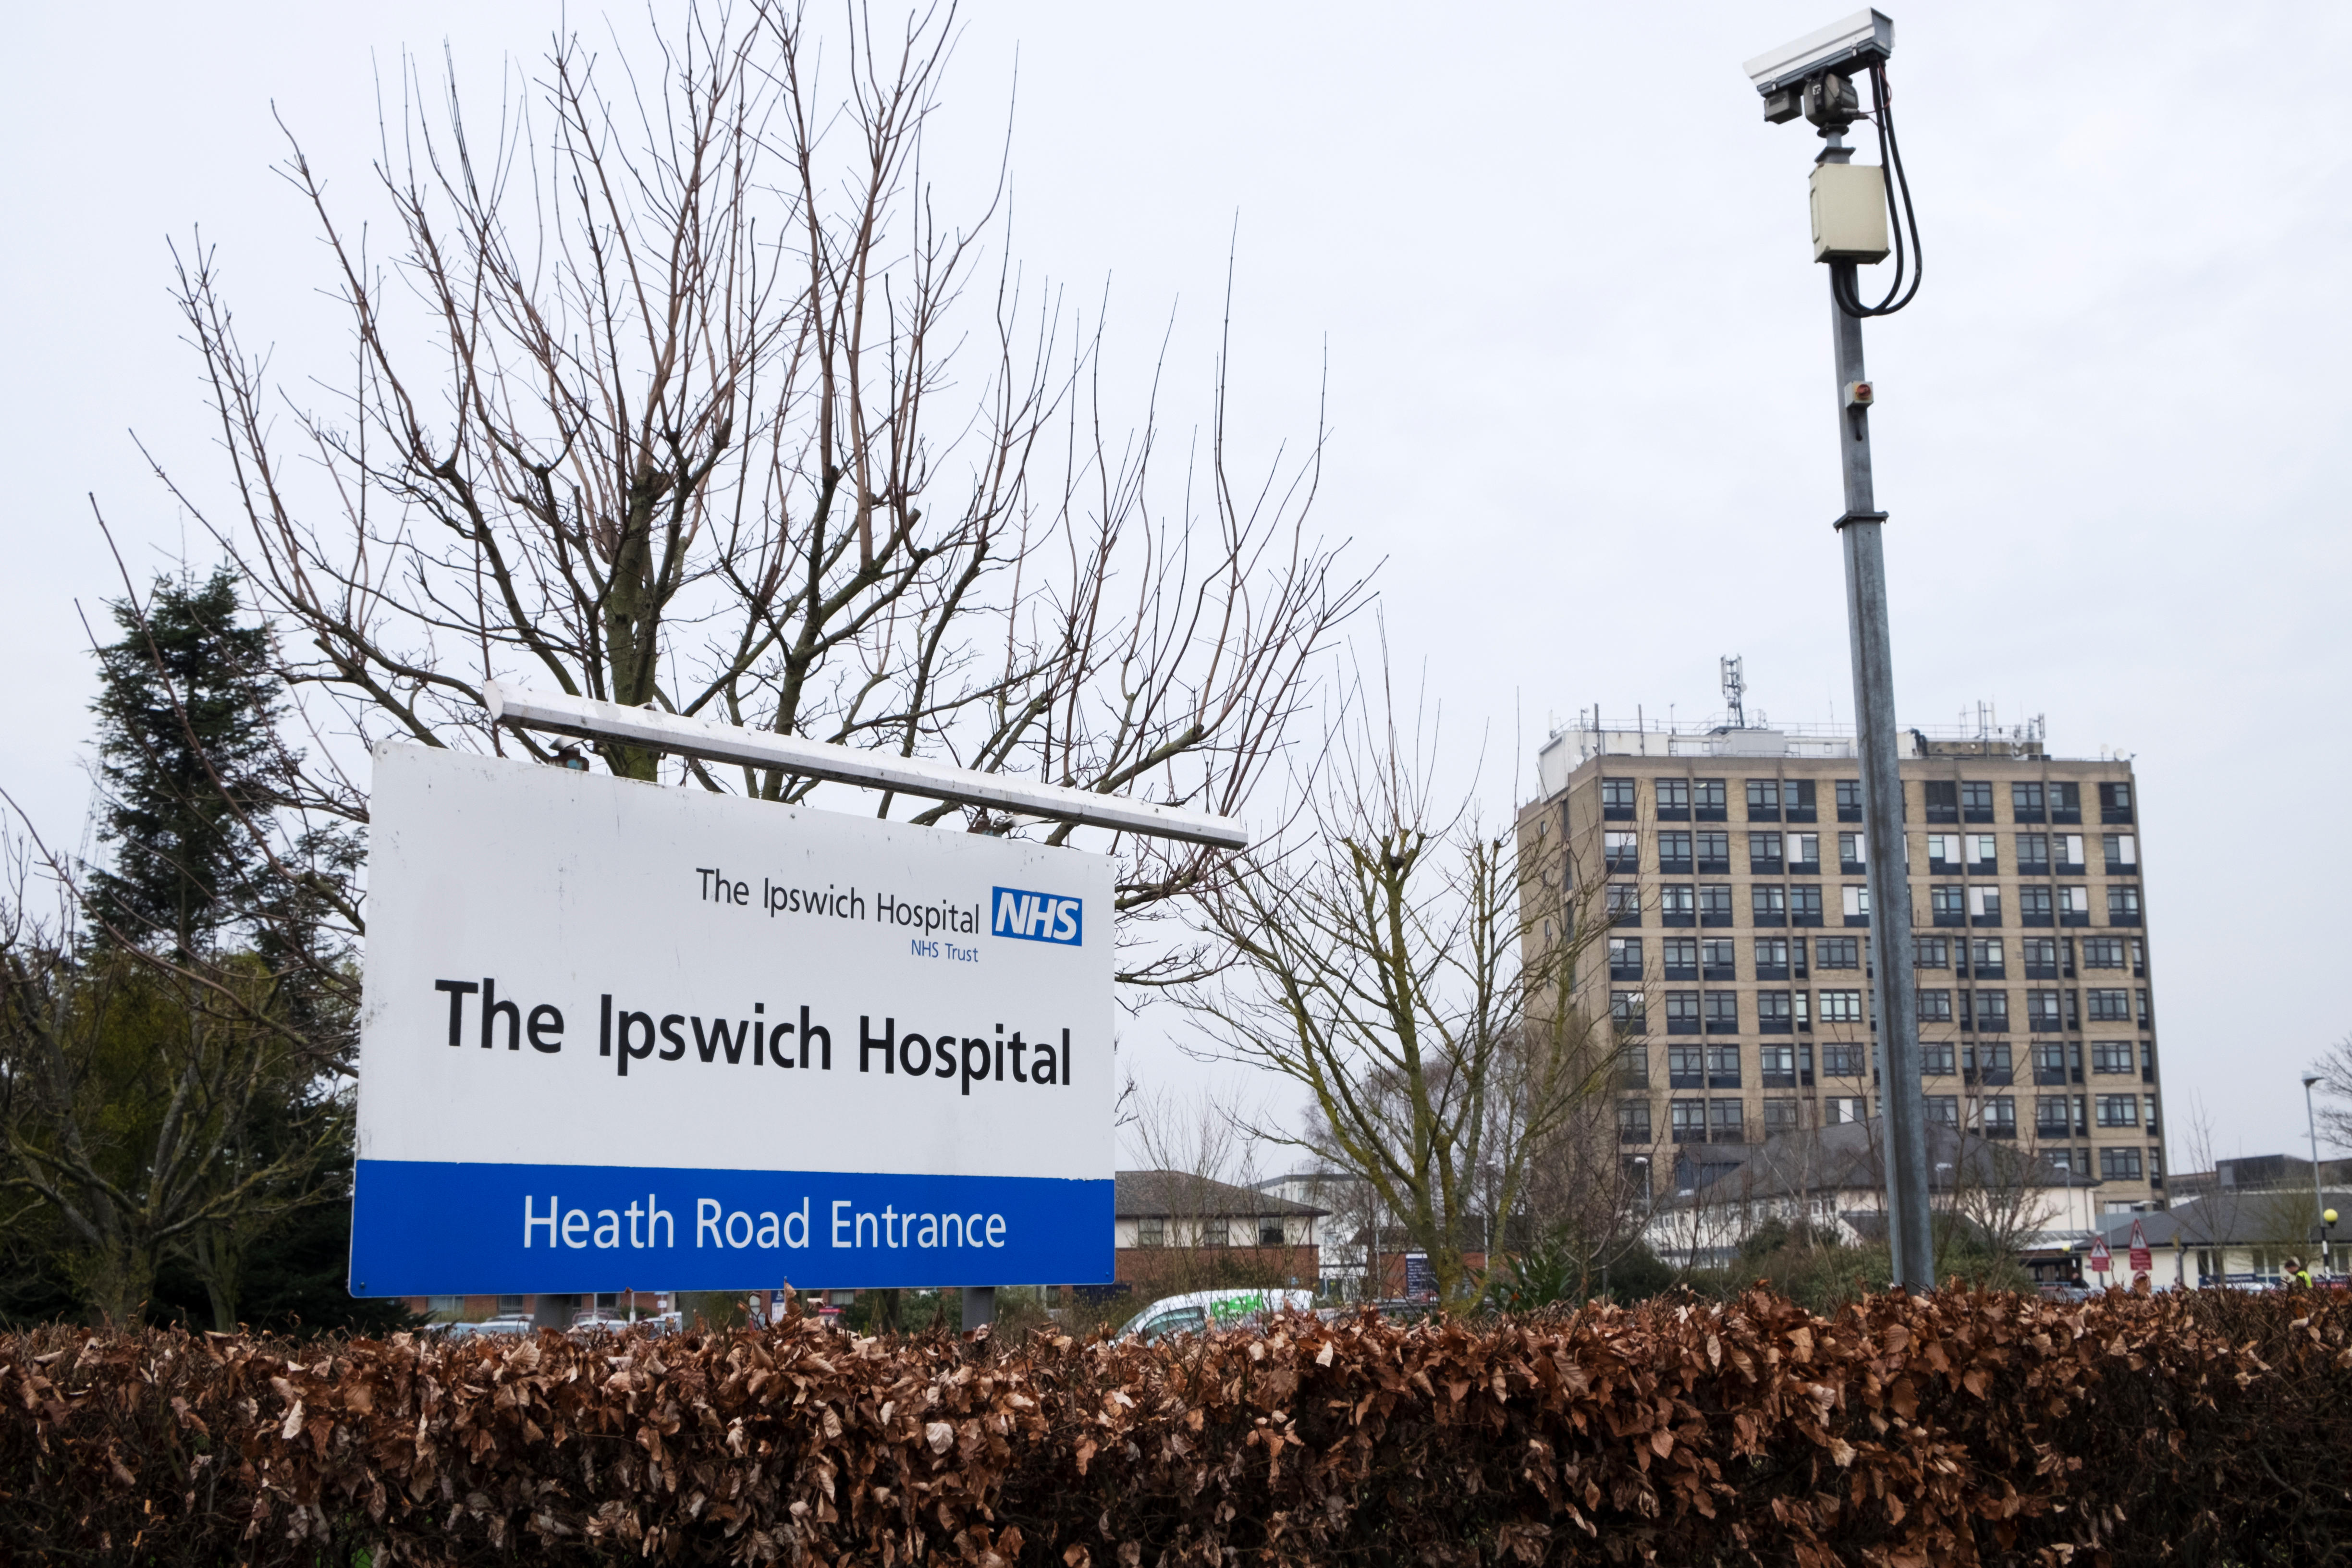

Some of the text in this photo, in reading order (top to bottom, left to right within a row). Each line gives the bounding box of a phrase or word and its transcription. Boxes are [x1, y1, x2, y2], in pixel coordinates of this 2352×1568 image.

[696, 867, 979, 936] The Ipswich Hospital
[994, 892, 1079, 942] NHS
[911, 939, 979, 963] NHS Trust
[435, 978, 1070, 1096] The Ipswich Hospital
[524, 1194, 1006, 1249] Heath Road Entrance
